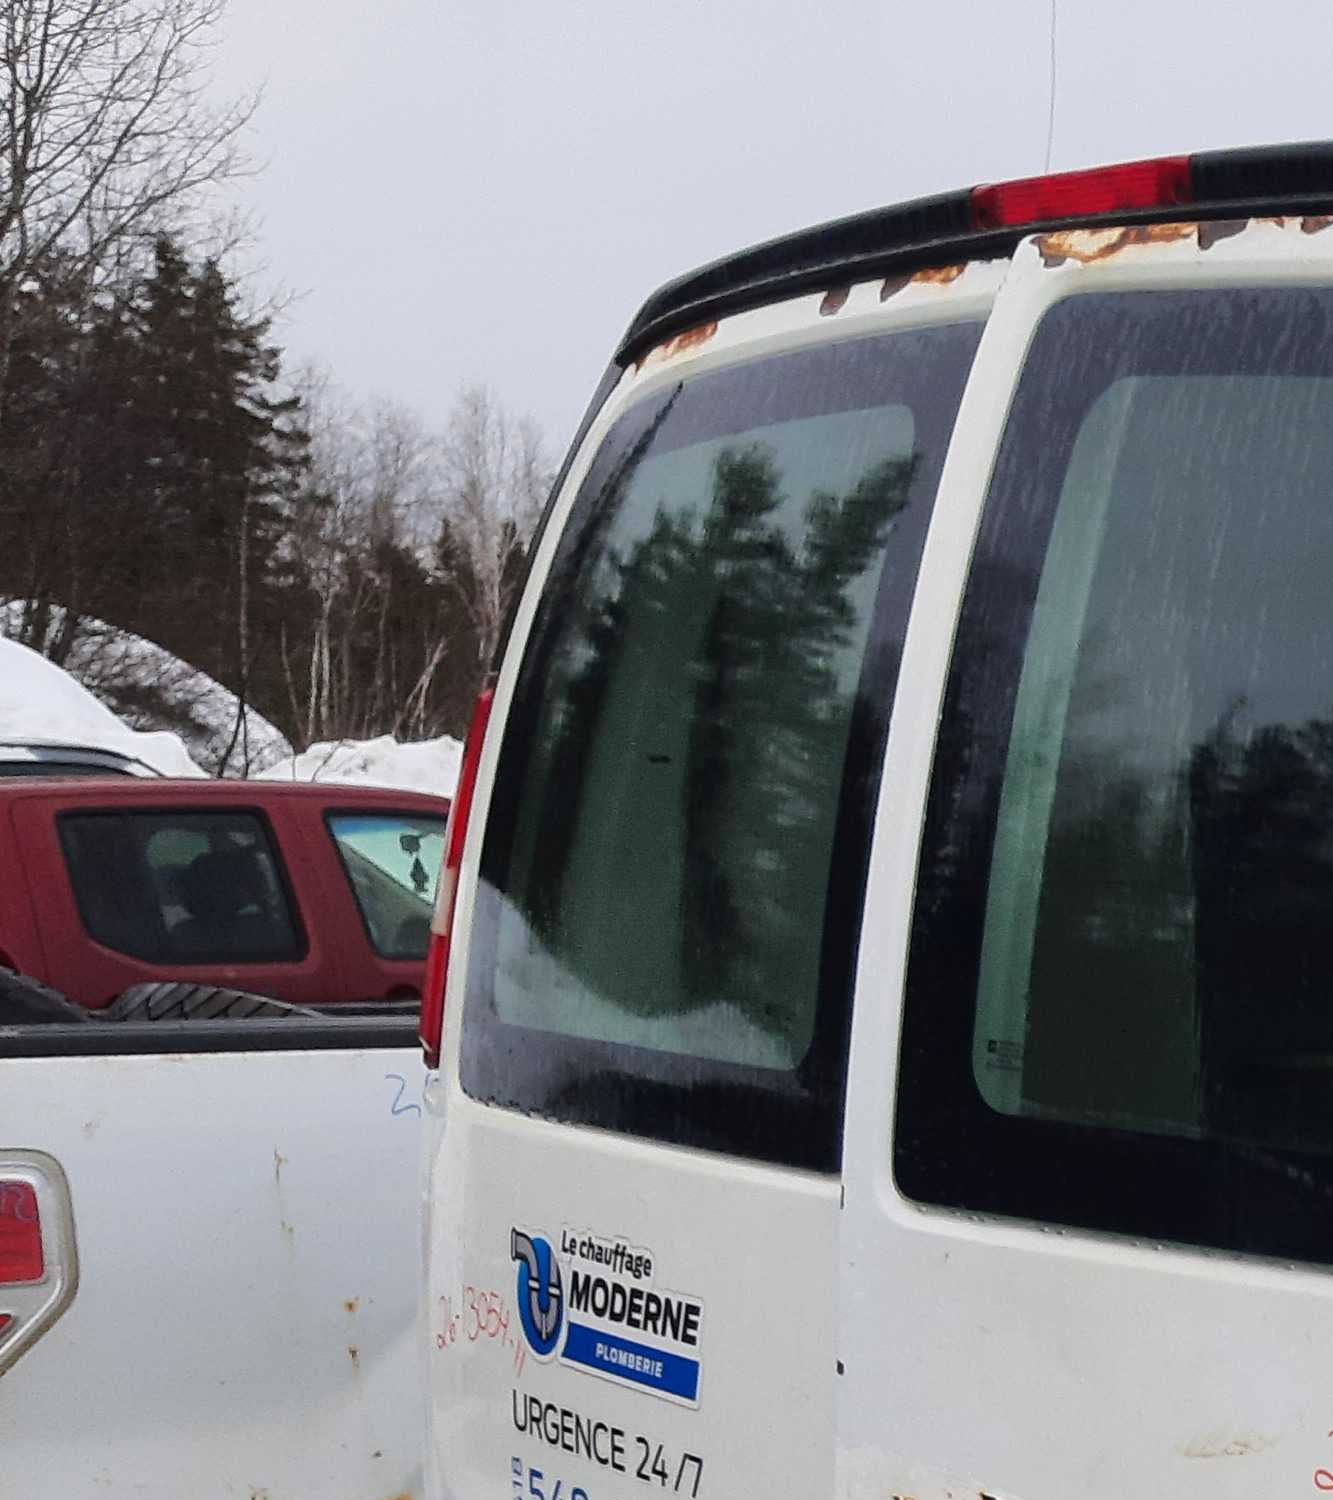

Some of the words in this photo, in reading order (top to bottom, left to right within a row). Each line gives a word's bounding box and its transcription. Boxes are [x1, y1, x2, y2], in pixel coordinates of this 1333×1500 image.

[561, 1230, 578, 1257] Le
[580, 1236, 653, 1281] chauffage
[569, 1270, 702, 1347] MODERNE
[594, 1342, 664, 1378] PLOMBERIE
[513, 1389, 627, 1473] URGENCE
